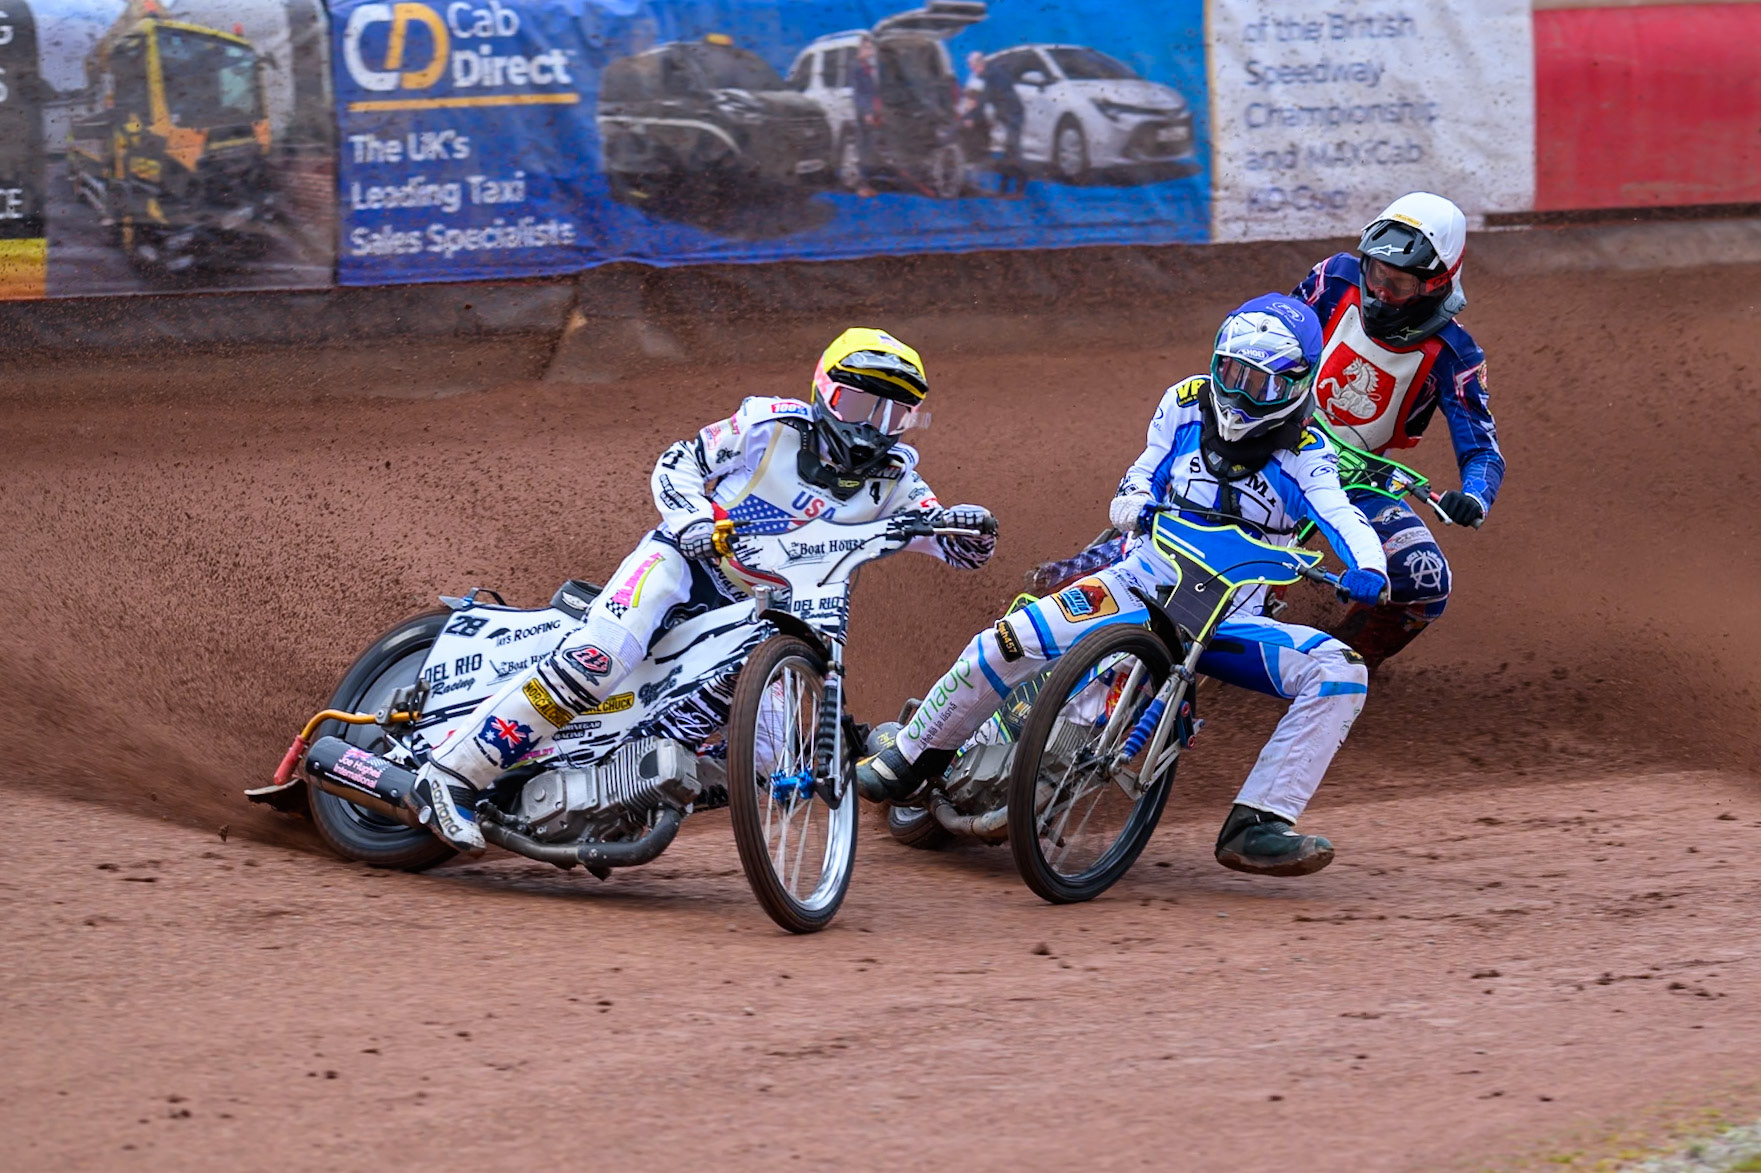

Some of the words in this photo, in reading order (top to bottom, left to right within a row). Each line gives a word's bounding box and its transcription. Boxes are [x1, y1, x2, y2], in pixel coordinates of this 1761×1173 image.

[447, 0, 520, 38] Cab
[1243, 15, 1271, 42] of
[1273, 17, 1323, 42] the
[1328, 12, 1417, 40] British
[452, 44, 572, 87] Direct
[1244, 57, 1385, 90] Speedway
[1245, 101, 1437, 131] Championship
[350, 133, 403, 163] The
[406, 129, 471, 161] UK's
[1245, 147, 1298, 171] and
[351, 176, 462, 213] Leading
[465, 170, 526, 204] Taxi
[351, 224, 424, 257] Sales
[426, 215, 577, 259] Specialists
[792, 490, 836, 520] USA
[800, 542, 825, 555] Boat
[829, 538, 865, 552] House
[793, 599, 814, 612] DEL
[818, 596, 839, 610] RIO
[445, 615, 491, 638] 28
[513, 619, 561, 643] ROOFING
[424, 661, 449, 683] DEL
[454, 653, 482, 677] RIO
[431, 677, 475, 698] Racing
[333, 763, 378, 789] International
